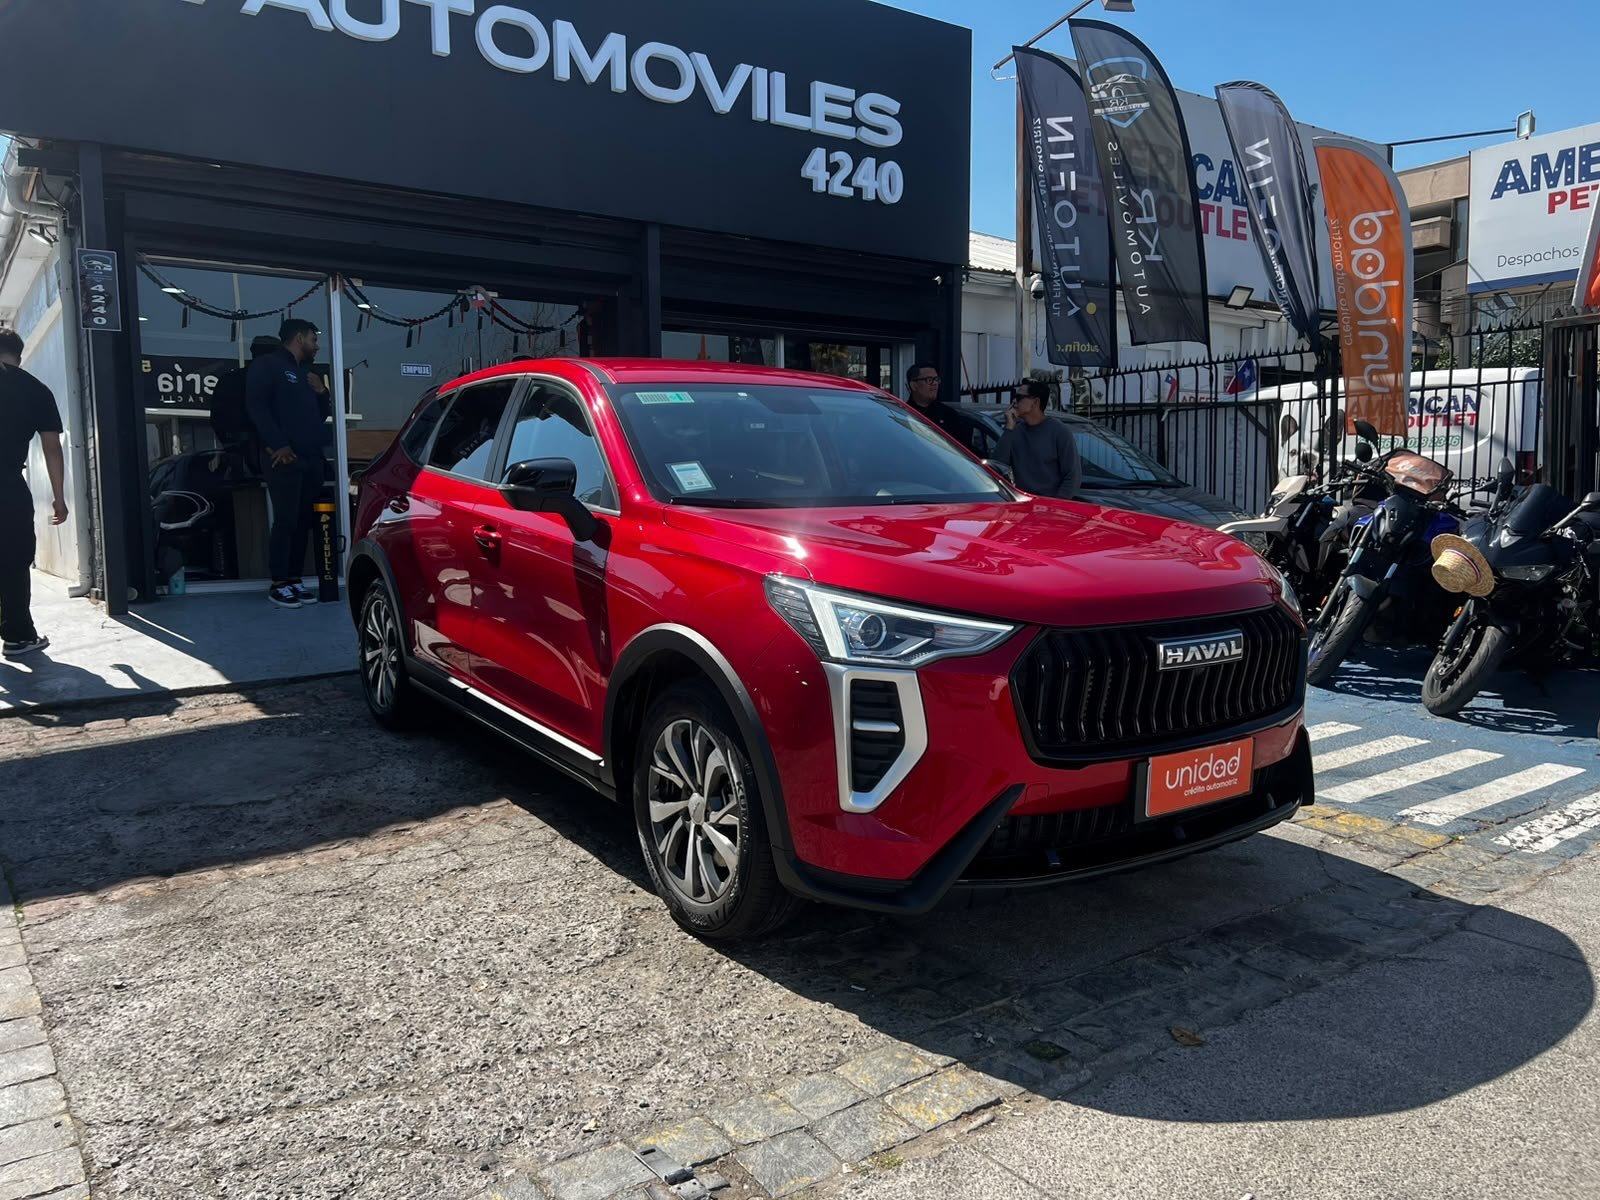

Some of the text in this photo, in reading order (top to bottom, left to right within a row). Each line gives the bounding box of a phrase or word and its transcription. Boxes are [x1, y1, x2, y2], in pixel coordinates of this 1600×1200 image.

[801, 147, 904, 205] 4240
[1548, 184, 1600, 214] PE
[1497, 246, 1580, 268] Despachos
[403, 365, 430, 375] EMPUJE
[1166, 640, 1242, 664] HAVAL
[1165, 747, 1241, 790] unidad
[1184, 777, 1238, 796] crédito automotriz
